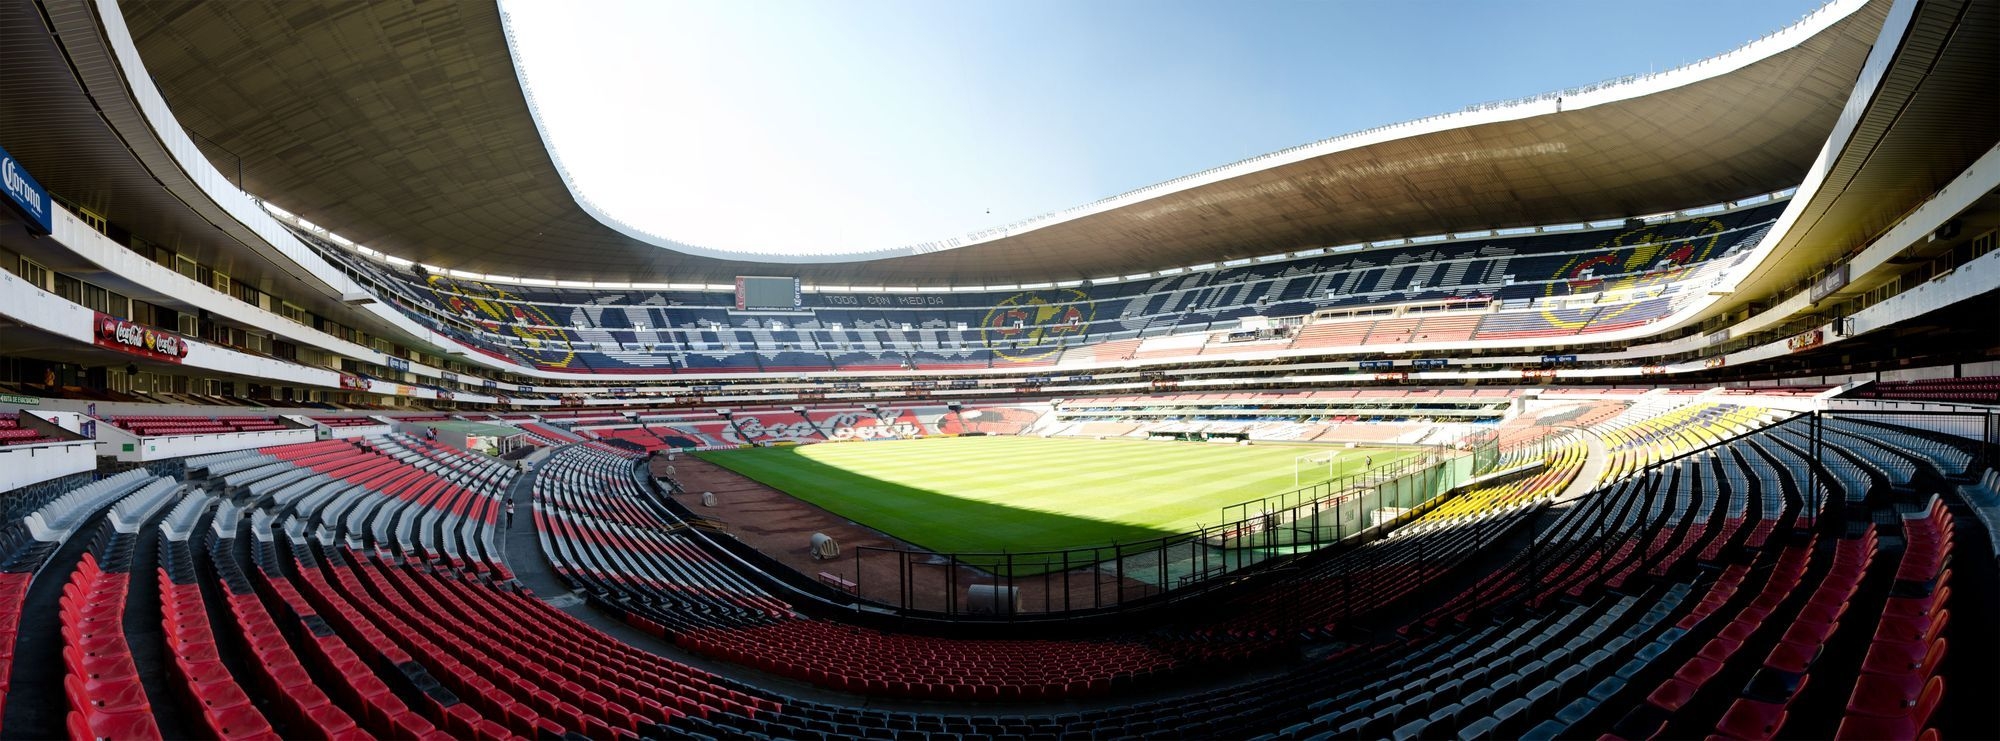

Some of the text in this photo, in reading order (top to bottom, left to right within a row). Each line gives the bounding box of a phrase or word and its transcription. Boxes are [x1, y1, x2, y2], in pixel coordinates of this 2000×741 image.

[2, 157, 42, 214] Corona
[794, 278, 802, 306] Corona
[825, 296, 943, 305] TODO CON MEDIDA
